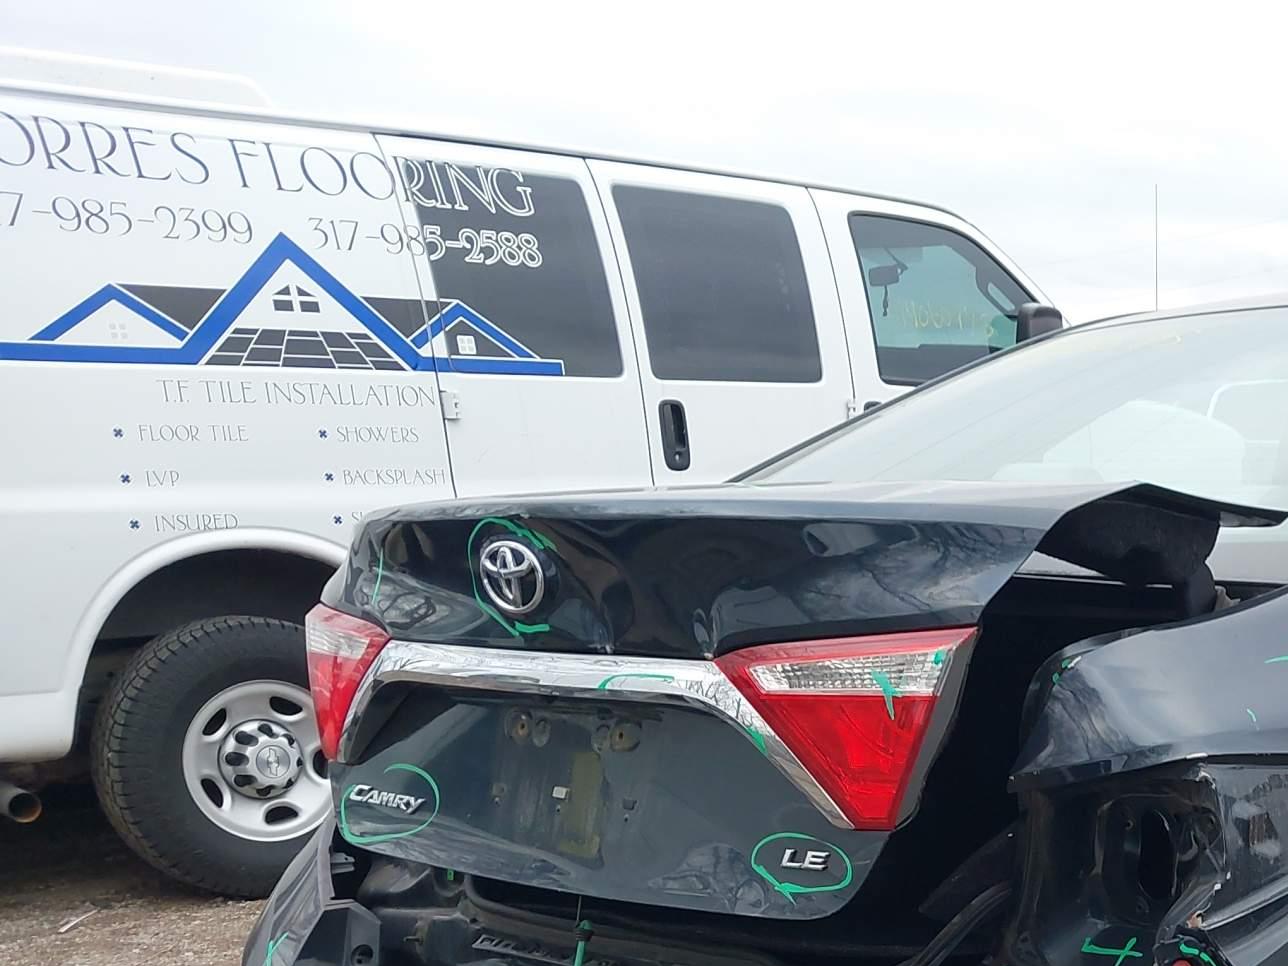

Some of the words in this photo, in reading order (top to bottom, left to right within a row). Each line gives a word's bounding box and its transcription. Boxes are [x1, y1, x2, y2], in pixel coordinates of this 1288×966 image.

[0, 111, 209, 184] ORRES
[228, 138, 535, 216] FLOORING
[0, 191, 253, 244] 7-985-2399
[308, 217, 543, 268] 317-985-2588
[199, 380, 256, 403] TILE
[265, 382, 435, 407] INSTALLATION
[138, 424, 200, 442] FLOOR
[208, 424, 248, 441] TILE
[336, 425, 419, 443] SHOWERS
[145, 470, 180, 487] LVP
[343, 468, 446, 485] BACKSPLASH
[154, 513, 238, 532] INSURED
[349, 784, 426, 814] CAMRY
[781, 848, 830, 871] LE
